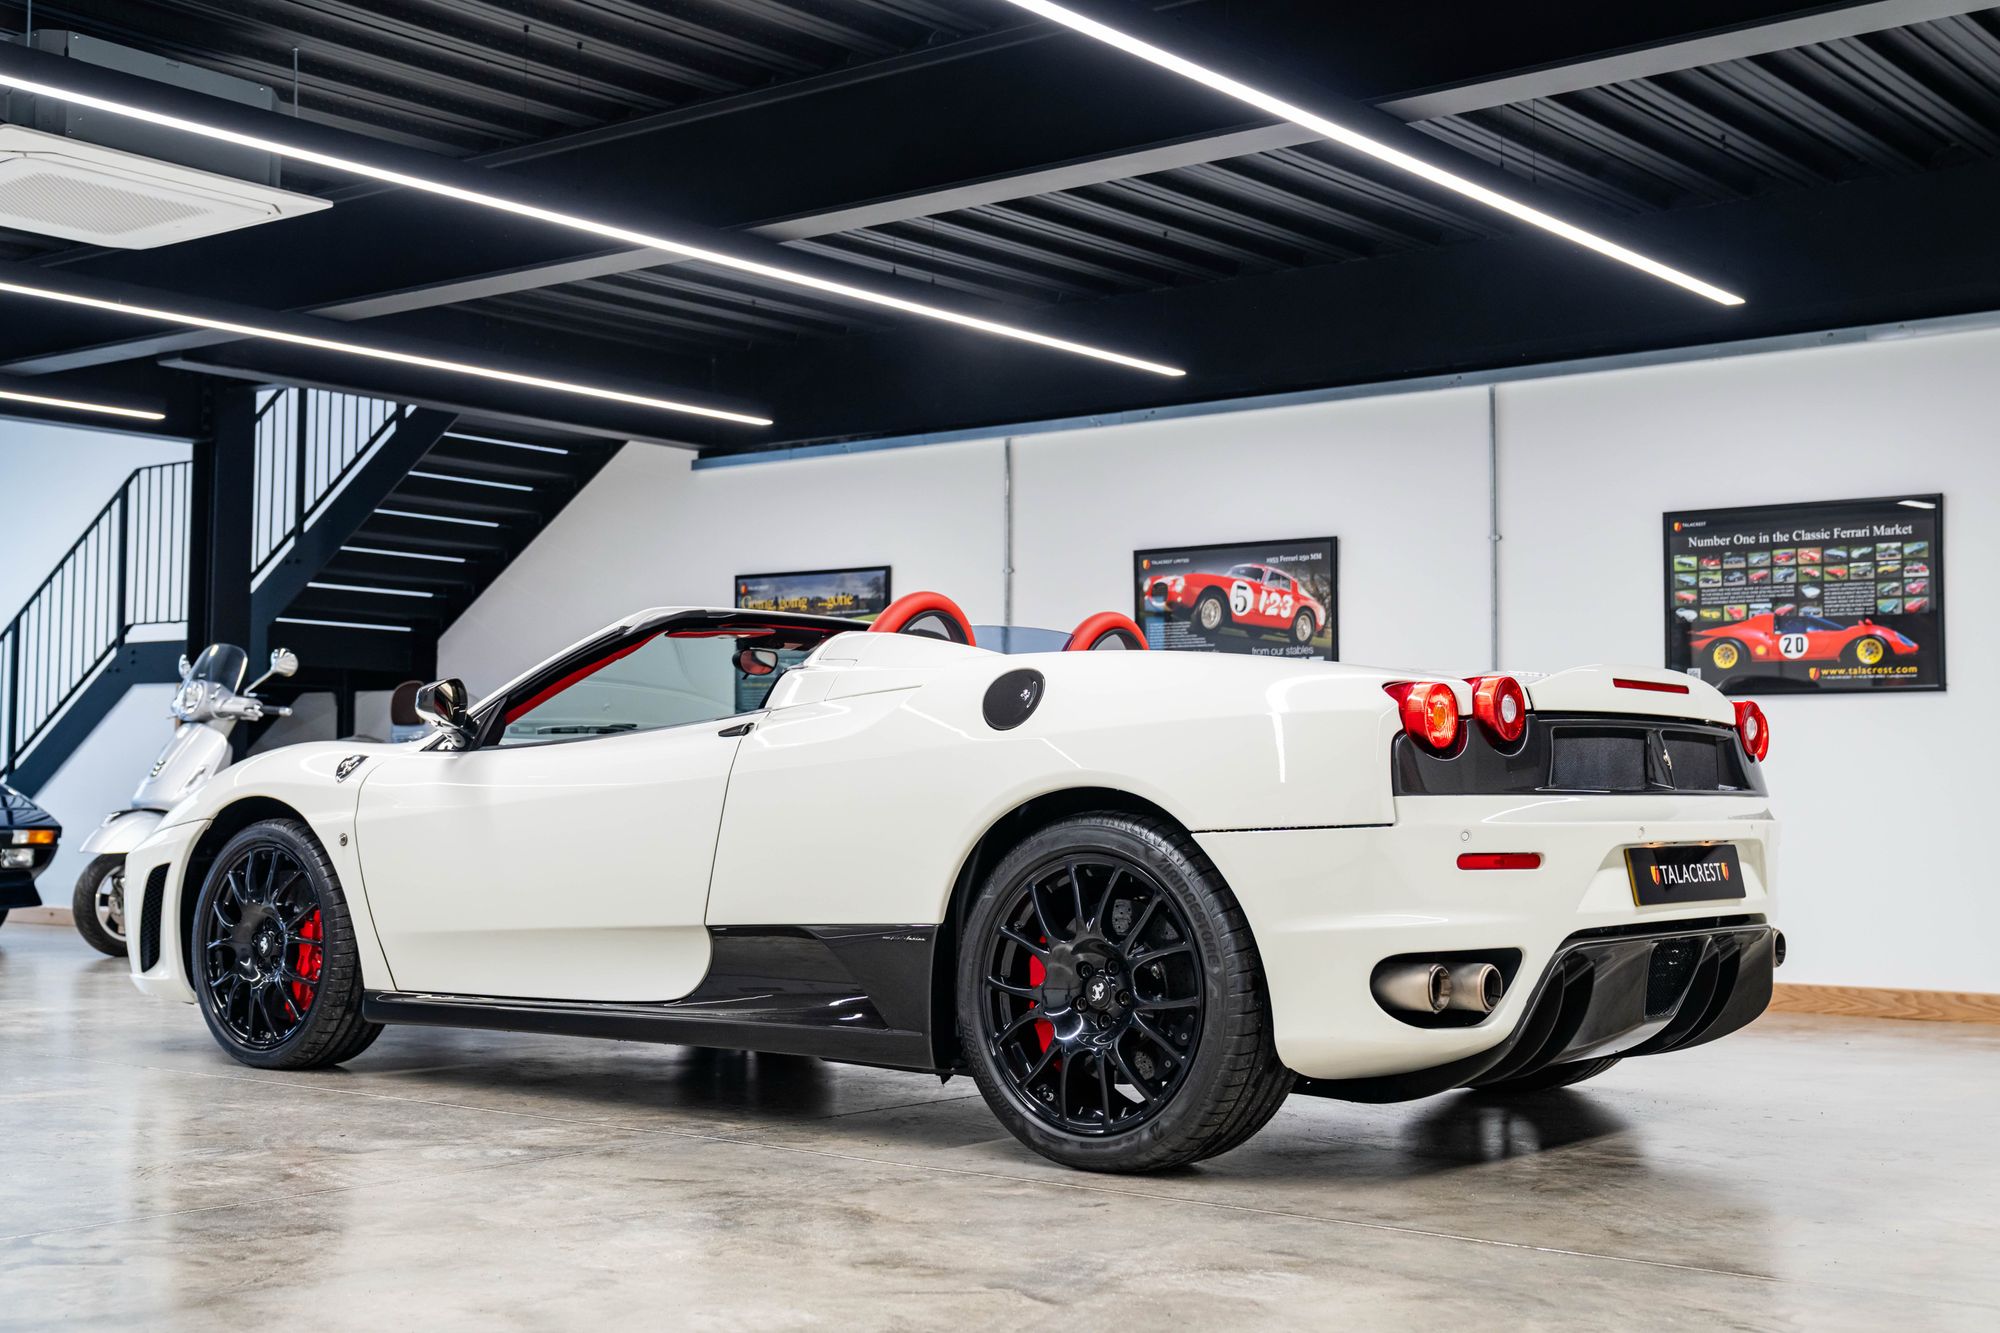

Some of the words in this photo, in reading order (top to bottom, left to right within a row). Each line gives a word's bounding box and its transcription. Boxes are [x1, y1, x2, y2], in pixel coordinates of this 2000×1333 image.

[1688, 535, 1731, 548] Number
[1733, 533, 1756, 545] One
[1759, 532, 1770, 543] in
[1772, 531, 1789, 542] the
[1792, 528, 1830, 541] Classic
[1833, 526, 1870, 539] Ferrari
[1872, 524, 1912, 537] Market
[1279, 554, 1298, 562] Ferrari
[1235, 585, 1247, 613] 5
[1251, 646, 1270, 655] from
[1271, 647, 1284, 655] our
[1285, 645, 1314, 655] stables
[1783, 636, 1804, 654] 20
[1821, 665, 1918, 677] www.talacrest.com
[1659, 862, 1722, 885] TALACREST
